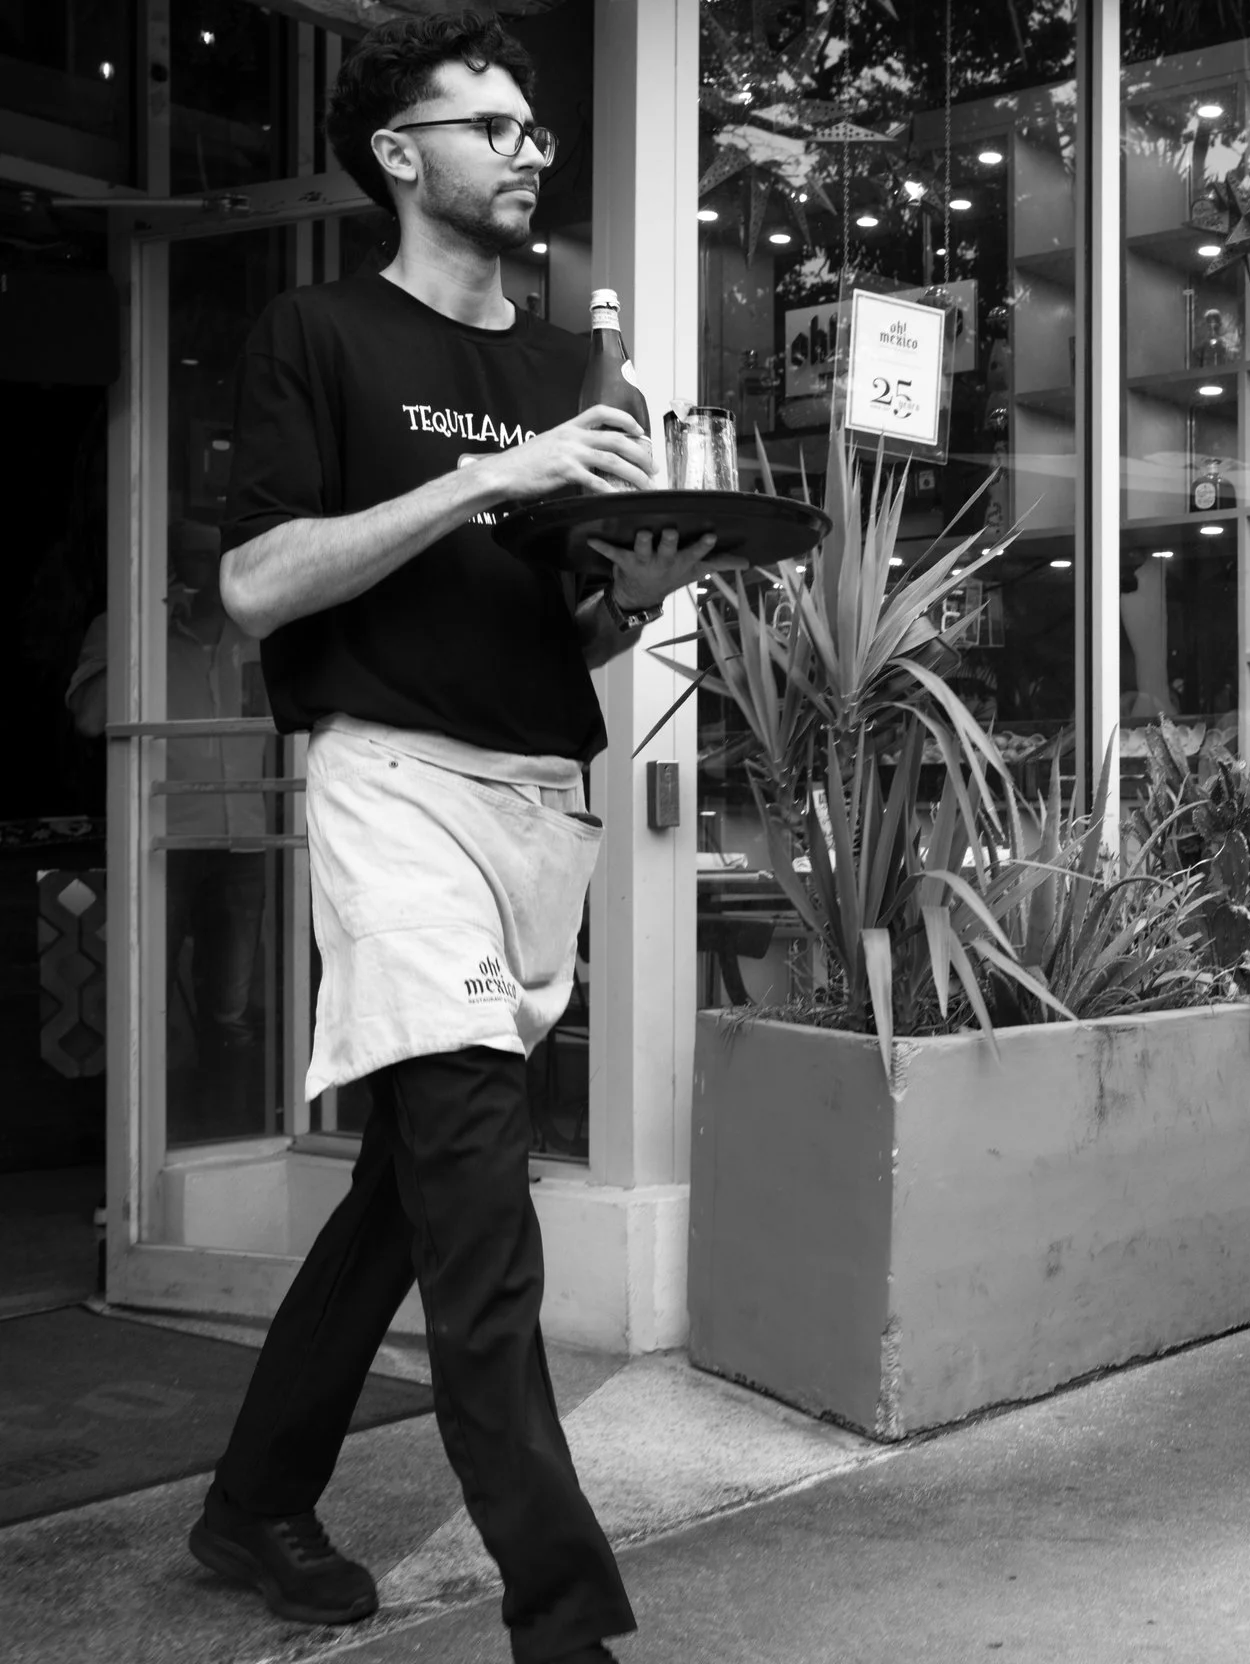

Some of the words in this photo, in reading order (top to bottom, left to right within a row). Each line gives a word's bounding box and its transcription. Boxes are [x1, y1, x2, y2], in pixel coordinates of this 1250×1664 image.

[889, 320, 907, 334] oh!
[879, 331, 918, 350] mexico
[869, 377, 913, 419] 25
[479, 954, 501, 977] oh!
[464, 974, 517, 1000] mexico
